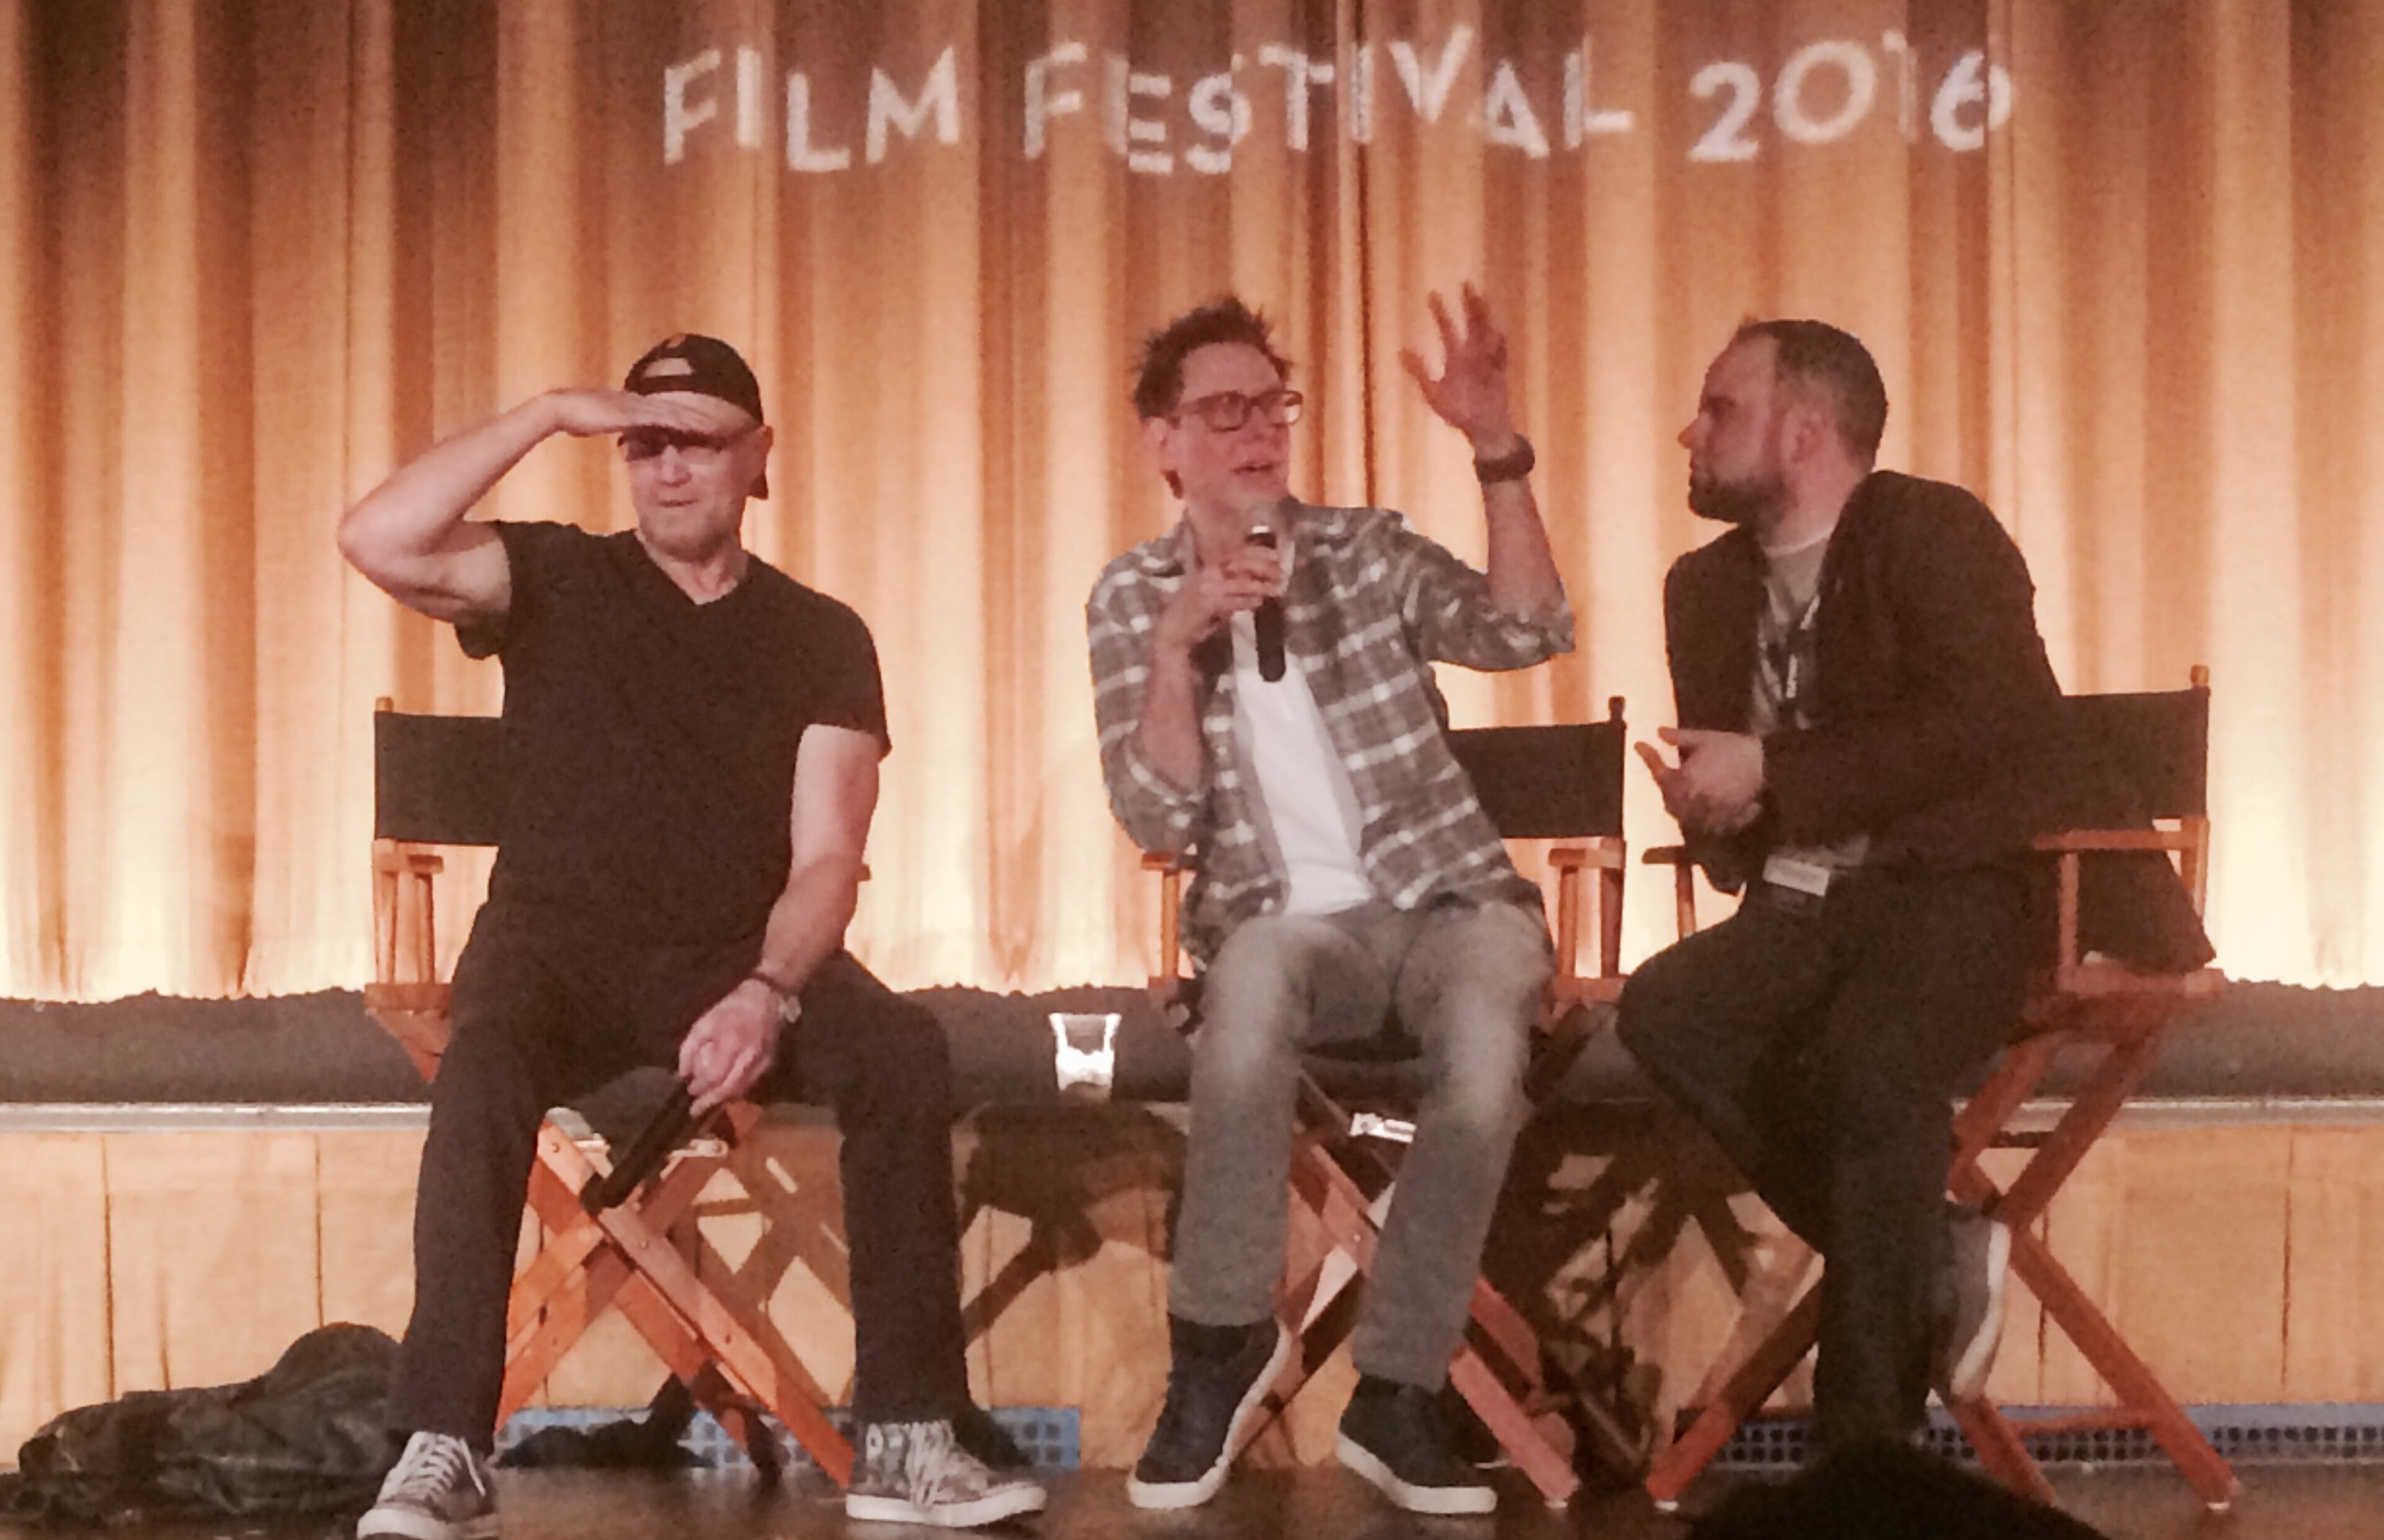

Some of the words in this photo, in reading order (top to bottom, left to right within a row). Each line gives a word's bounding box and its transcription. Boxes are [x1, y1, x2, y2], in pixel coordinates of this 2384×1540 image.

[664, 45, 960, 172] FILM
[1024, 24, 1635, 174] FESTIVAL
[1689, 29, 2013, 162] 2016
